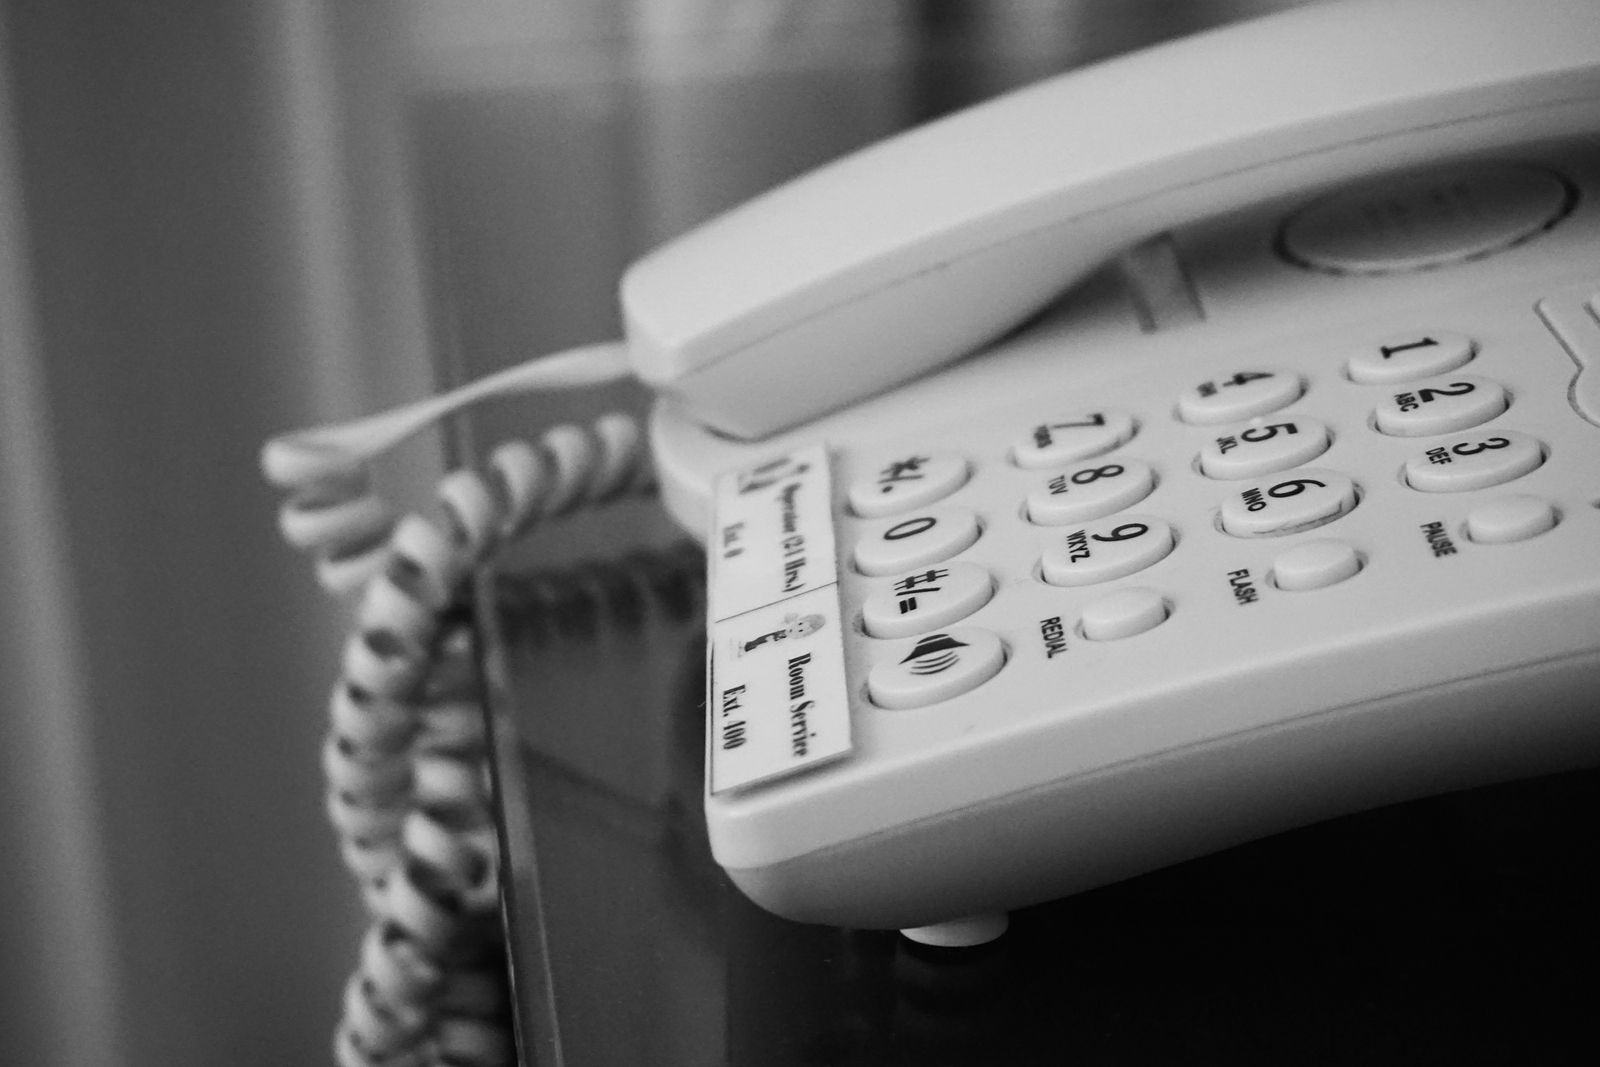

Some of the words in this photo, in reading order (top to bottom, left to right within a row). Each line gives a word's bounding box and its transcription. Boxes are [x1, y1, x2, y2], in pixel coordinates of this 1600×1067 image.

[1380, 337, 1439, 359] 1
[1222, 371, 1275, 388] 4
[1394, 392, 1420, 412] ABC
[1418, 382, 1475, 403] 2
[1240, 423, 1298, 442] 5
[1216, 435, 1238, 455] JKL
[1425, 446, 1452, 465] DEF
[1452, 437, 1510, 456] 3
[1048, 475, 1068, 495] TUV
[1071, 464, 1124, 485] 8
[1268, 479, 1326, 498] 6
[1241, 488, 1267, 512] MNO
[883, 517, 937, 540] 0
[1091, 523, 1148, 542] 9
[1066, 529, 1091, 563] WXYZ
[1420, 521, 1458, 558] PAUSE
[1227, 568, 1259, 605] FLASH
[1040, 616, 1068, 659] REDIAL
[788, 652, 811, 700] Room
[723, 684, 746, 717] Ext.
[723, 720, 747, 750] 400
[790, 700, 816, 756] Service
